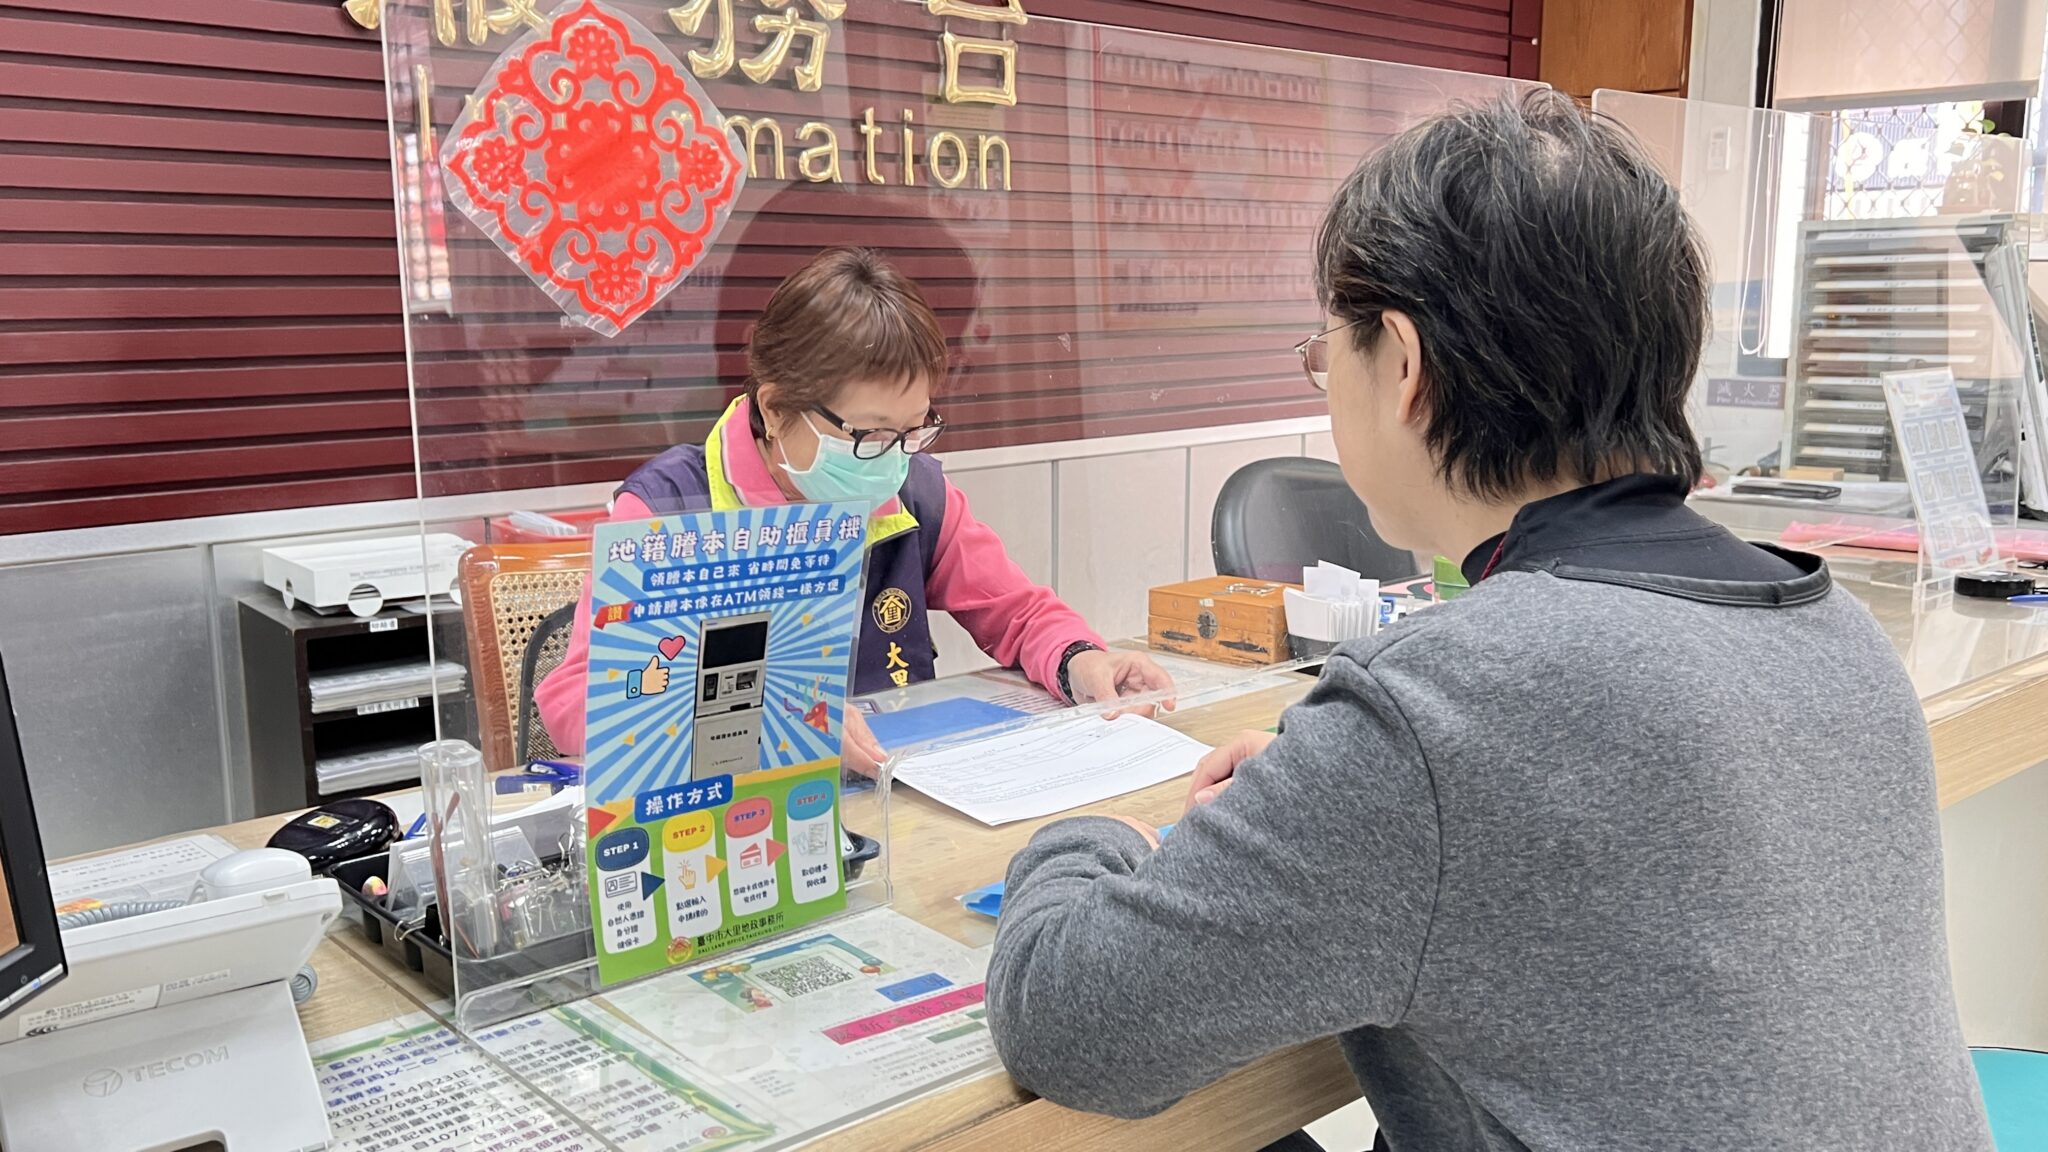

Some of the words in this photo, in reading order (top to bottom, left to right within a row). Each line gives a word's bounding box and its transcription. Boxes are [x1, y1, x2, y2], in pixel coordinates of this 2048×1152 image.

[608, 514, 862, 563] 地籍謄本自助櫃員機
[650, 564, 741, 587] 領謄本自己來
[747, 554, 831, 576] 省時間免等待
[607, 604, 624, 621] 讚
[645, 782, 723, 816] 操作方式
[796, 795, 821, 806] STEP
[734, 812, 757, 823] STEP
[673, 827, 697, 839] STEP
[603, 843, 630, 857] STEP
[633, 841, 639, 850] 1
[617, 901, 632, 911] 使用
[697, 912, 784, 947] 臺中市大里地政事務所
[127, 1045, 230, 1083] TECOM
